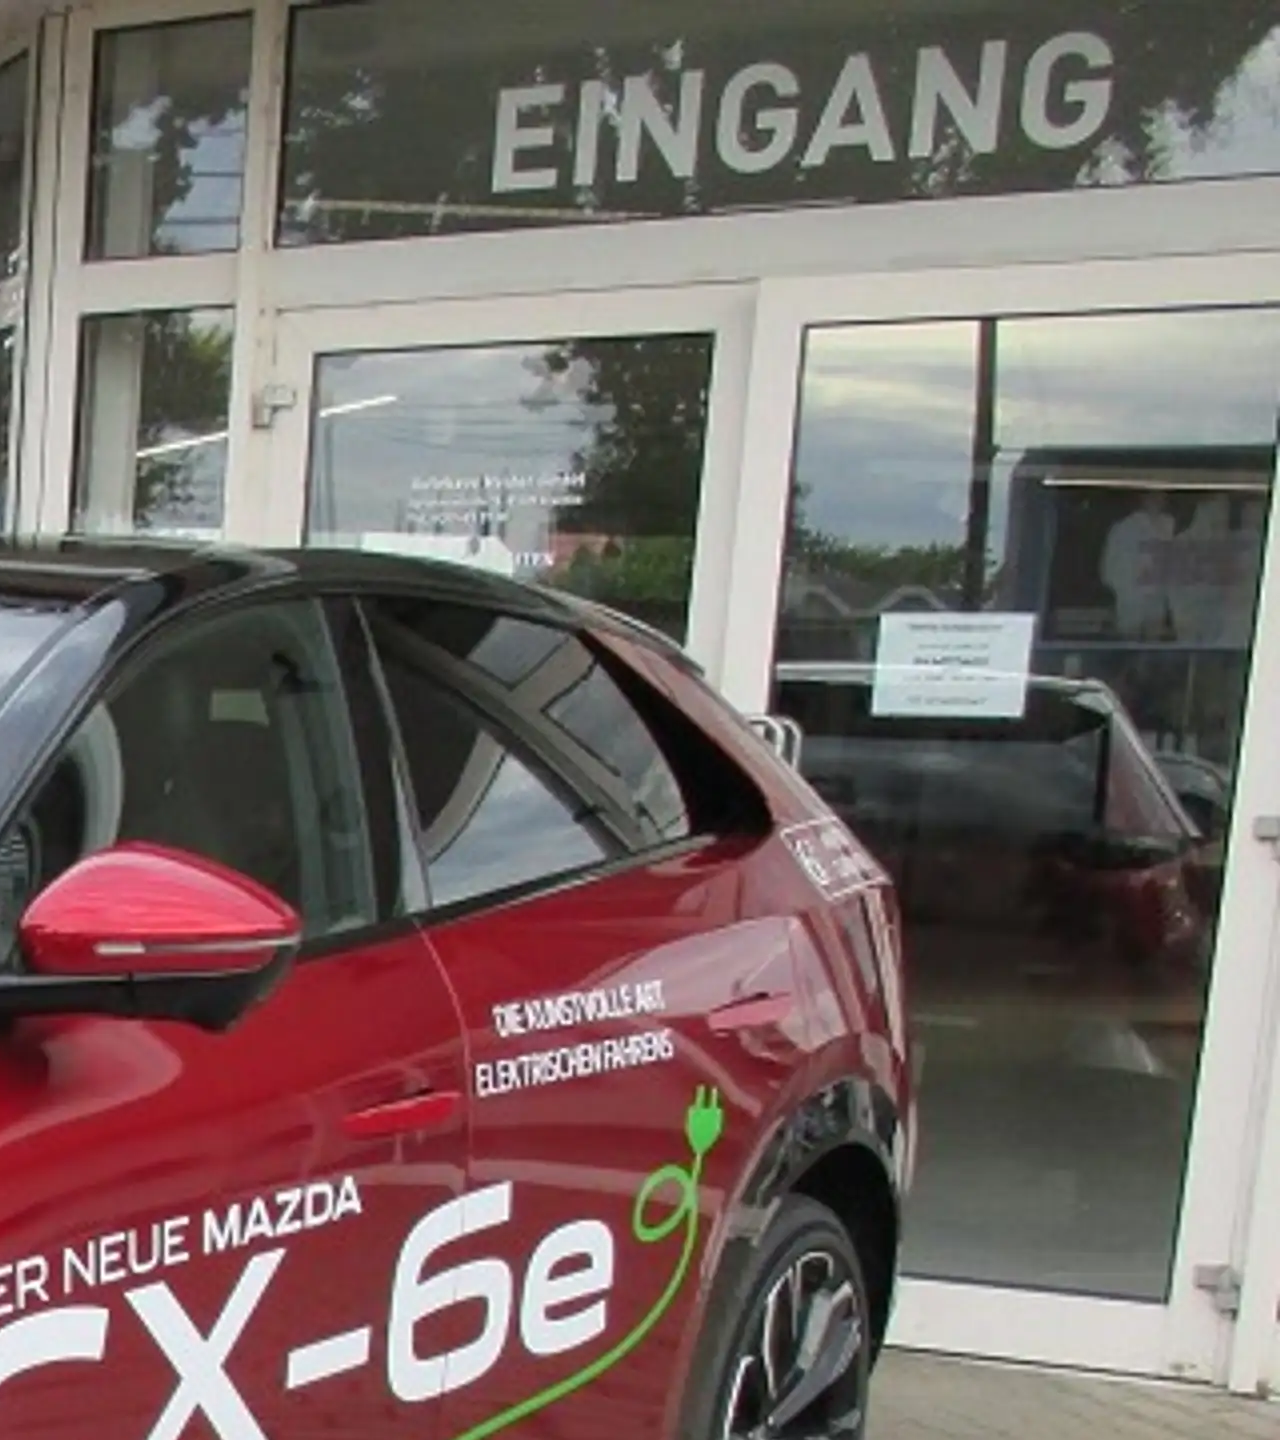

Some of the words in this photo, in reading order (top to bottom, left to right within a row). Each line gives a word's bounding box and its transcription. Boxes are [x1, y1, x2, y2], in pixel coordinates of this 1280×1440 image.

[491, 31, 1114, 192] EINGANG
[492, 1002, 527, 1037] DIE
[526, 983, 633, 1030] KUNSTVOLLE
[634, 979, 666, 1013] ART
[476, 1043, 602, 1097] ELEKTRISCHEN
[603, 1028, 674, 1070] FAHRENS
[63, 1215, 190, 1294] NEUE
[202, 1175, 362, 1255] MAZDA
